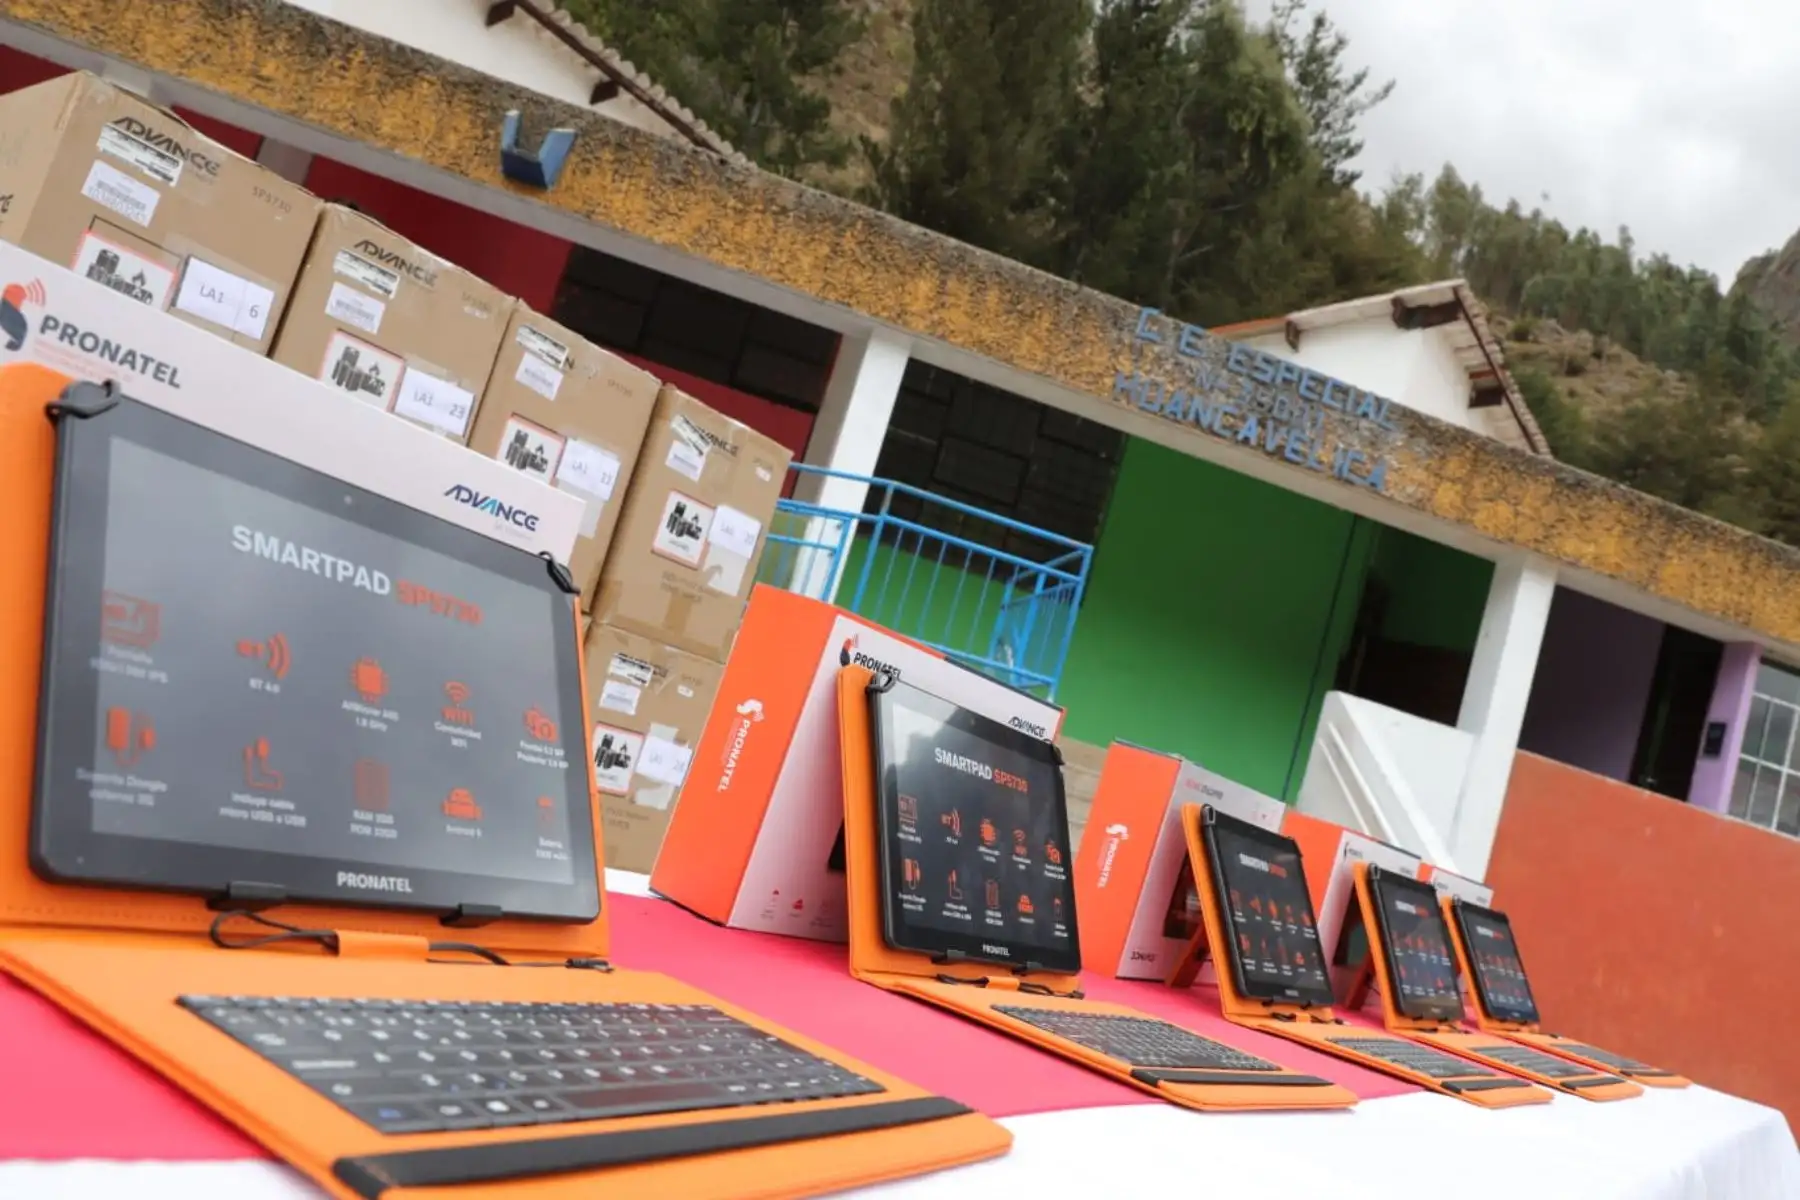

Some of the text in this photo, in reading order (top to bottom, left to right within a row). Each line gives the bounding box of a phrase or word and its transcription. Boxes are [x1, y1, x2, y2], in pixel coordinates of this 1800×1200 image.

[199, 285, 260, 320] LA1 6
[40, 314, 181, 390] PRONATEL
[1229, 343, 1398, 434] ESPECIAL
[1114, 370, 1390, 493] HUANCAVELICA
[443, 484, 540, 534] ADVANCE
[231, 525, 391, 597] SMARTPAD
[717, 719, 751, 793] PRONATEL
[934, 747, 992, 781] SMARTPAD
[337, 871, 413, 893] PRONATEL
